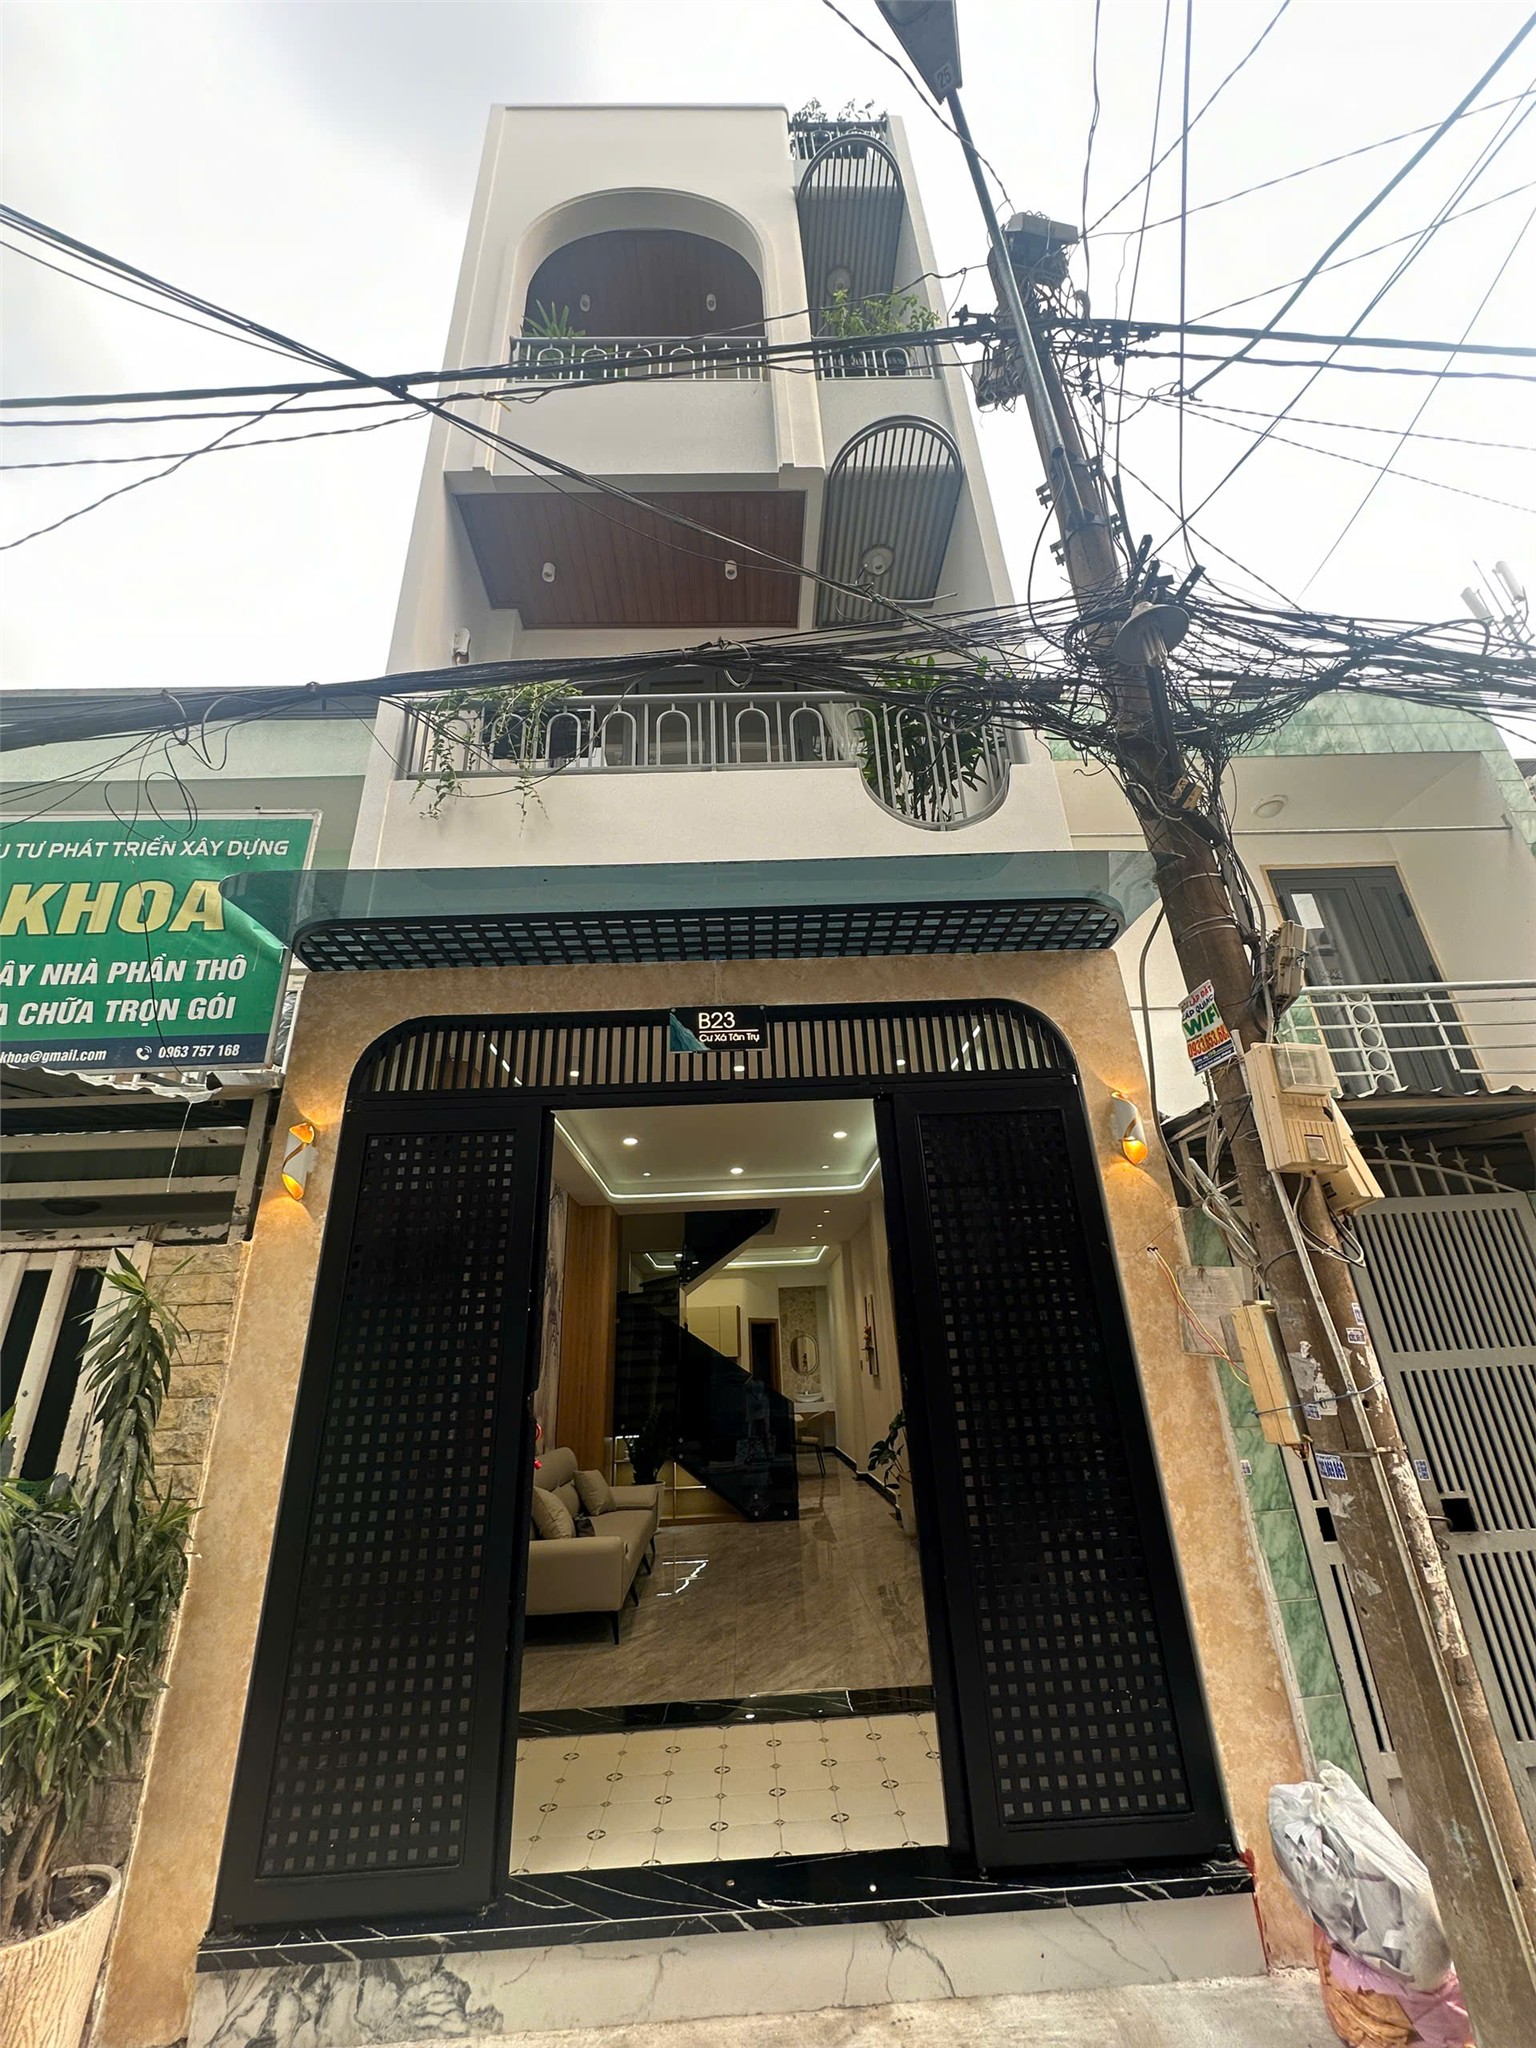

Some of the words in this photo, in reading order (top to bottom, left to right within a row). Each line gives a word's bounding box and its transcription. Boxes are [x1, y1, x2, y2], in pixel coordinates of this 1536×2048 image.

[937, 65, 952, 89] 25
[16, 841, 47, 859] TƯ
[47, 838, 109, 858] PHÁT
[113, 835, 177, 857] TRIỂN
[179, 837, 224, 857] XÂY
[227, 838, 290, 860] DỰNG
[0, 879, 225, 936] KHOA
[39, 958, 99, 986] NHÀ
[107, 953, 187, 984] PHẦN
[195, 954, 248, 981] THÔ
[18, 996, 94, 1026] CHỮA
[106, 998, 181, 1027] TRỌN
[187, 992, 237, 1020] GÓI
[698, 1011, 736, 1030] B23
[1182, 1003, 1220, 1037] WIFI
[0, 1049, 107, 1064] khoa@gmail.com
[158, 1046, 189, 1059] 0963
[191, 1045, 215, 1058] 757
[218, 1044, 240, 1057] 168
